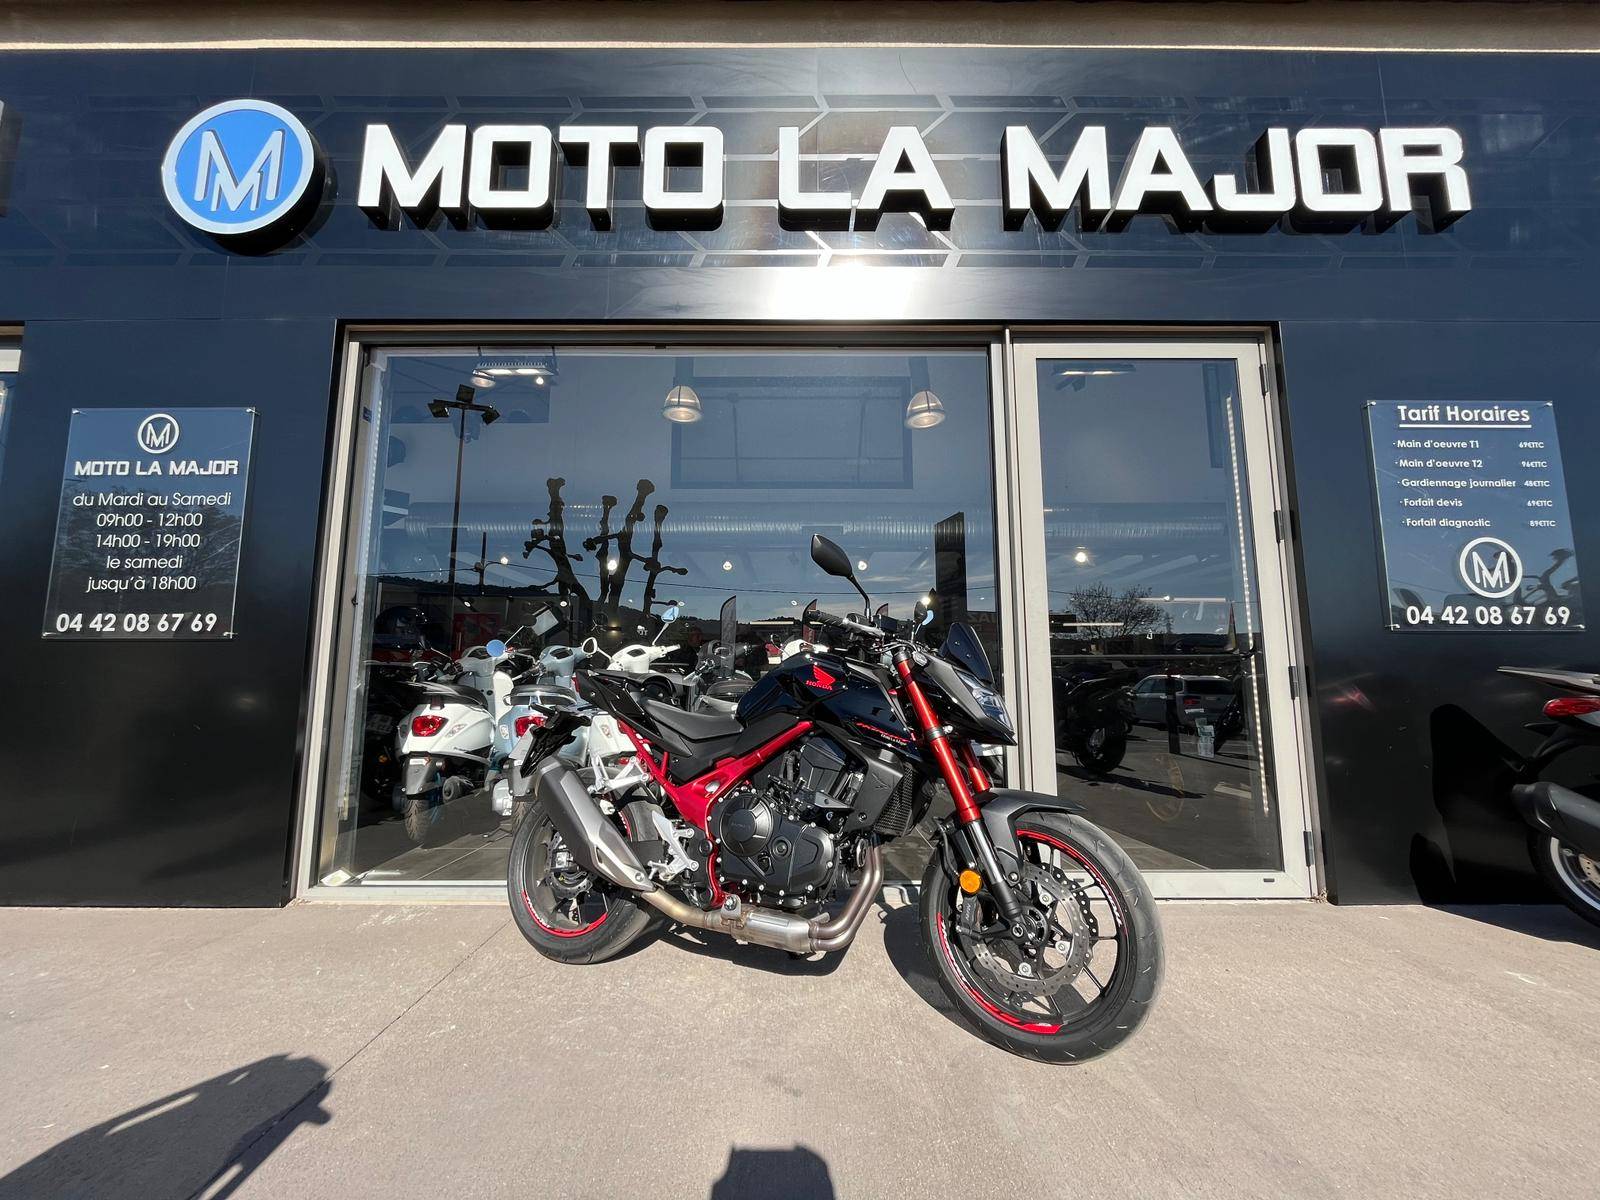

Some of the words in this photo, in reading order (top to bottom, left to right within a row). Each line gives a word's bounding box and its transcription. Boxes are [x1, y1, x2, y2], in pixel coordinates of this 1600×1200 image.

[357, 123, 725, 210] MOTO
[778, 125, 954, 211] LA
[1006, 125, 1471, 212] MAJOR
[1397, 405, 1440, 422] Tarif
[1446, 405, 1530, 422] Horaires
[1397, 439, 1422, 449] Main
[1424, 439, 1468, 449] d'oeuvre
[1470, 440, 1479, 449] T1
[74, 460, 130, 476] MOTO
[135, 460, 163, 476] LA
[168, 460, 239, 476] MAJOR
[1399, 459, 1424, 468] Main
[1426, 459, 1470, 468] d'oeuvre
[1472, 459, 1483, 468] T2
[1401, 478, 1468, 489] Gardiennage
[1470, 478, 1516, 489] journalier
[72, 492, 95, 507] du
[98, 492, 144, 507] Mardi
[147, 495, 168, 507] au
[172, 492, 232, 507] Samedi
[1403, 498, 1434, 507] Forfait
[1436, 498, 1463, 507] devis
[96, 513, 144, 527] 09h00
[159, 513, 203, 527] 12h00
[1406, 518, 1437, 527] Forfait
[1439, 518, 1491, 529] diagnostic
[96, 534, 141, 548] 14h00
[156, 534, 201, 548] 19h00
[106, 555, 121, 569] le
[124, 555, 184, 569] samedi
[151, 576, 197, 590] 18h00
[1406, 605, 1434, 625] 04
[1441, 605, 1469, 625] 42
[1475, 605, 1503, 625] 08
[1510, 606, 1536, 625] 67
[1544, 606, 1571, 625] 69
[56, 613, 83, 632] 04
[89, 613, 117, 632] 42
[123, 613, 150, 632] 08
[157, 613, 185, 632] 67
[190, 613, 218, 632] 69
[805, 679, 833, 691] HONDA
